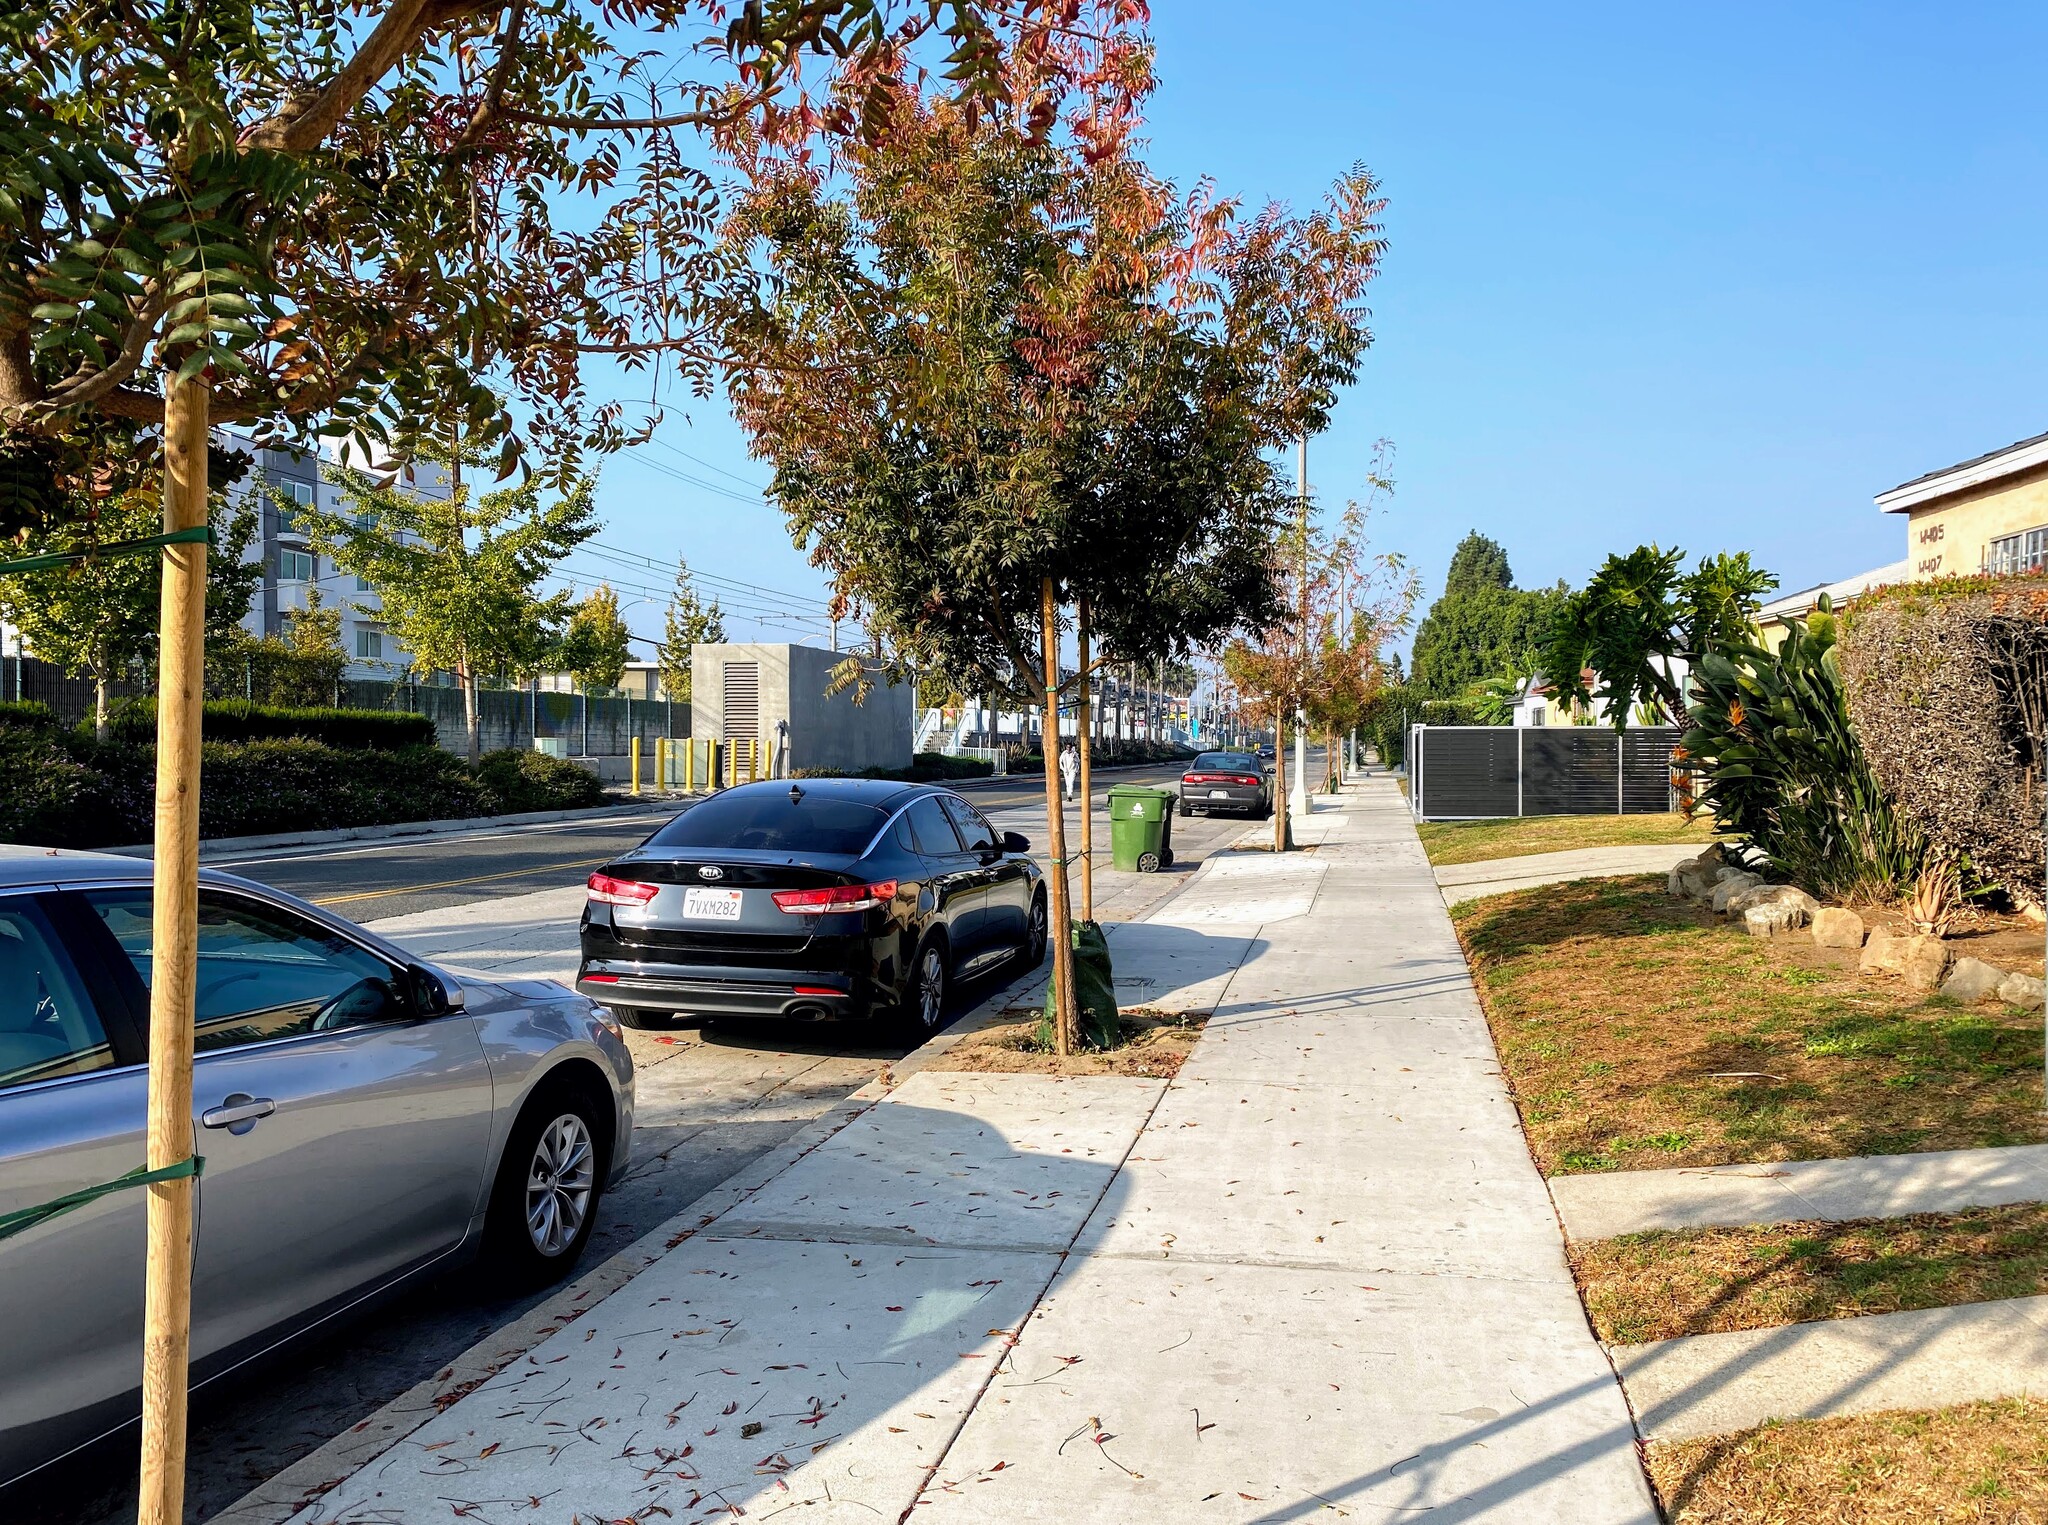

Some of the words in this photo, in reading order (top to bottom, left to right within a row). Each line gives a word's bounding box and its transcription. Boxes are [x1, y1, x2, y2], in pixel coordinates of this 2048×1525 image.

[1920, 524, 1944, 545] 4405
[1918, 555, 1942, 575] 4407
[701, 868, 720, 877] KIA
[689, 899, 737, 916] 7VXM282
